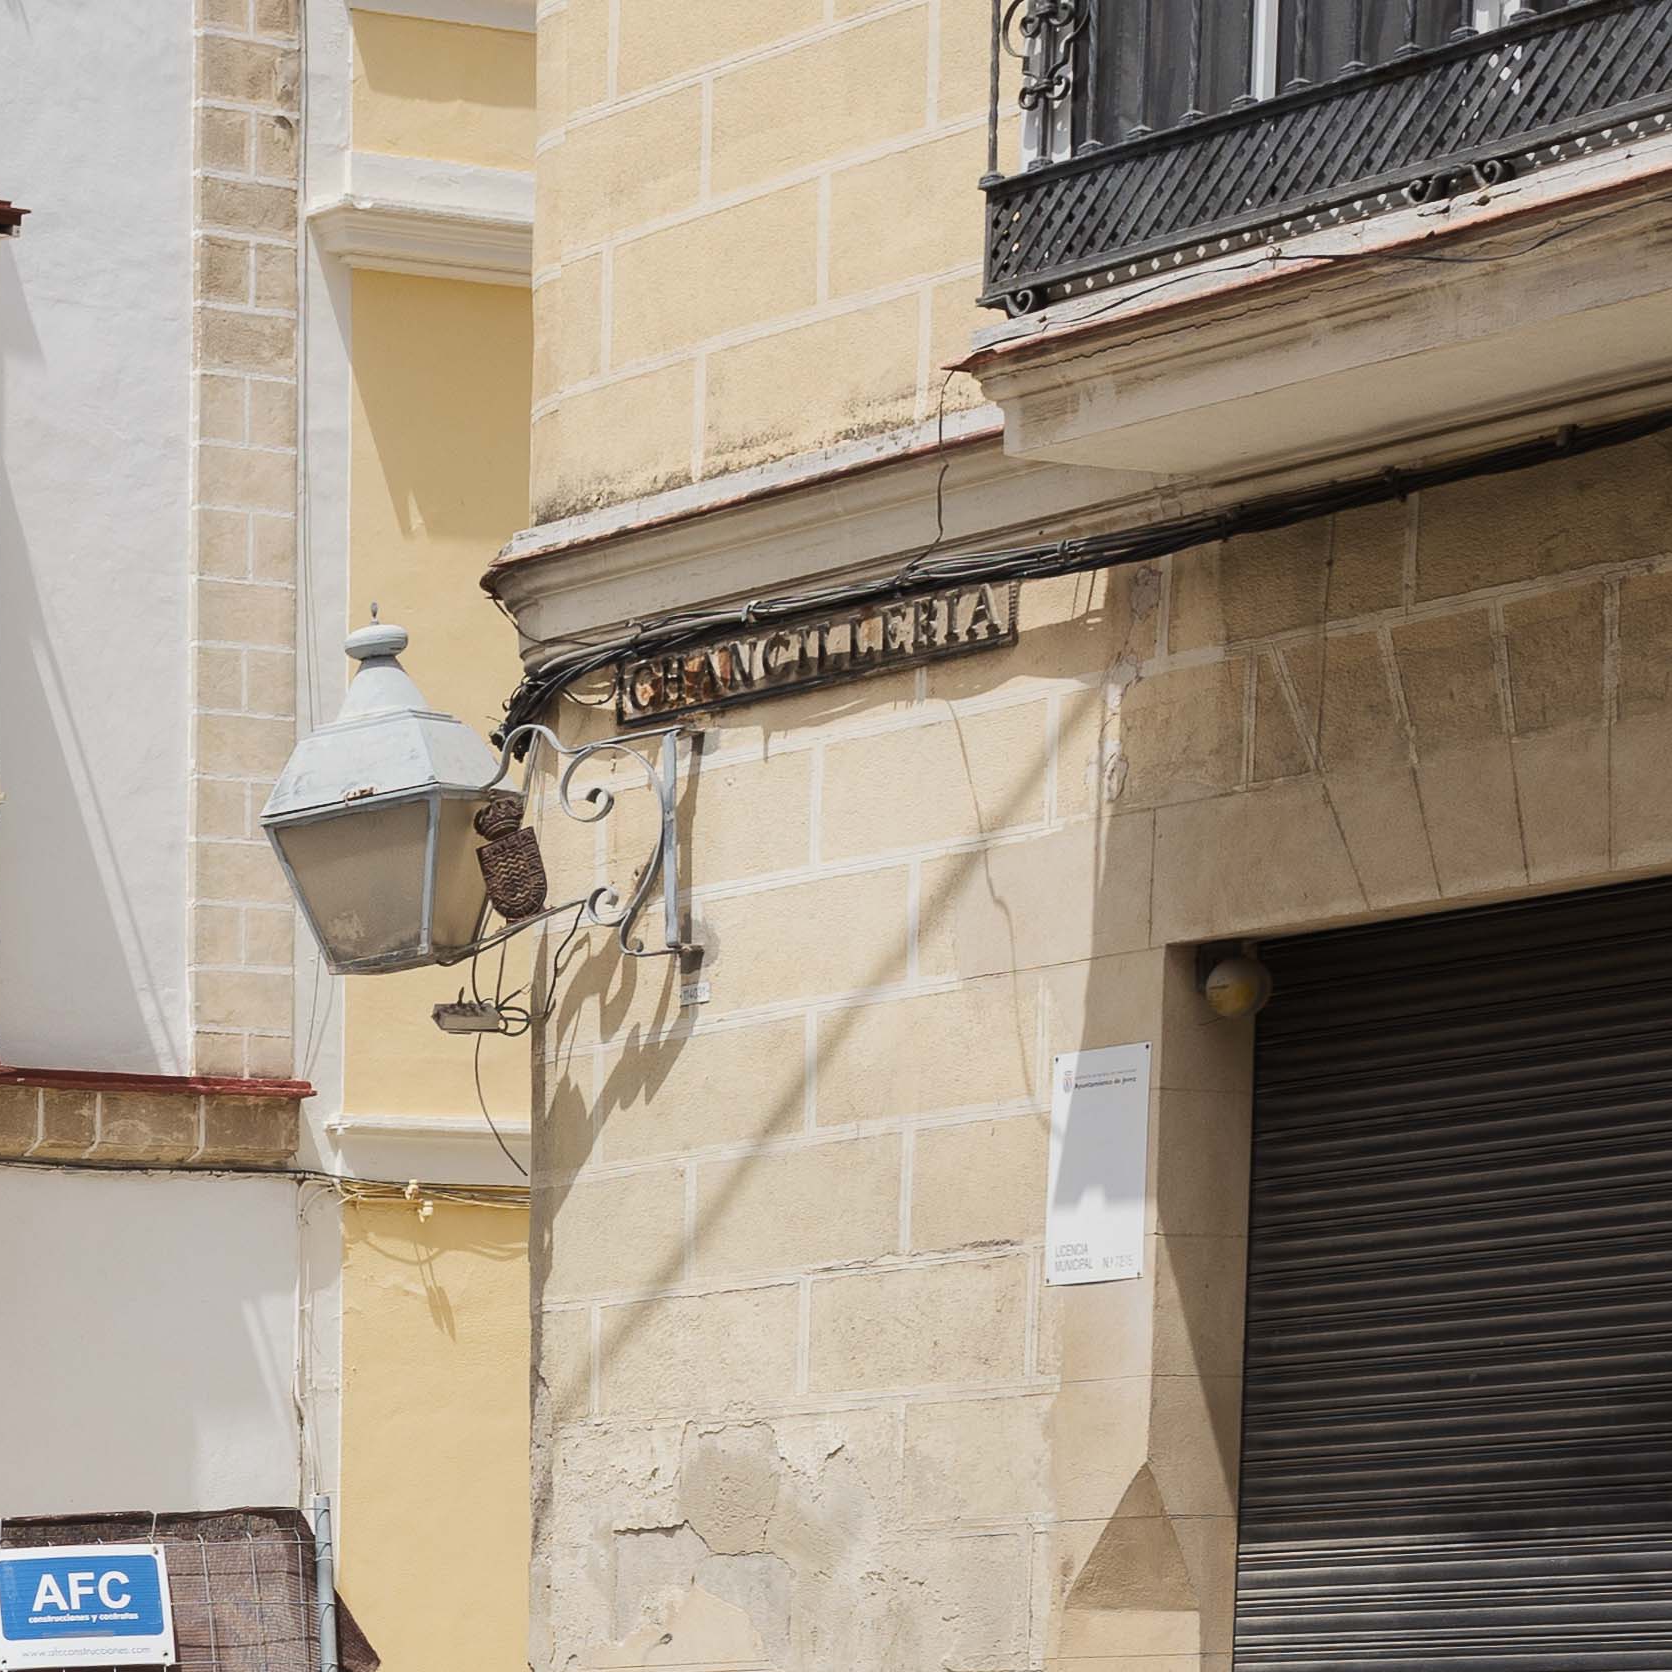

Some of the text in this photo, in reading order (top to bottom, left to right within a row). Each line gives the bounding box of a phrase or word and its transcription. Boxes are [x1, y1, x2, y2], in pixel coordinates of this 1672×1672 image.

[629, 583, 1001, 711] CHANCILLERIA
[1055, 1243, 1088, 1258] LICENCIA
[32, 1570, 131, 1612] AFC
[28, 1612, 139, 1624] construcciones y contratas
